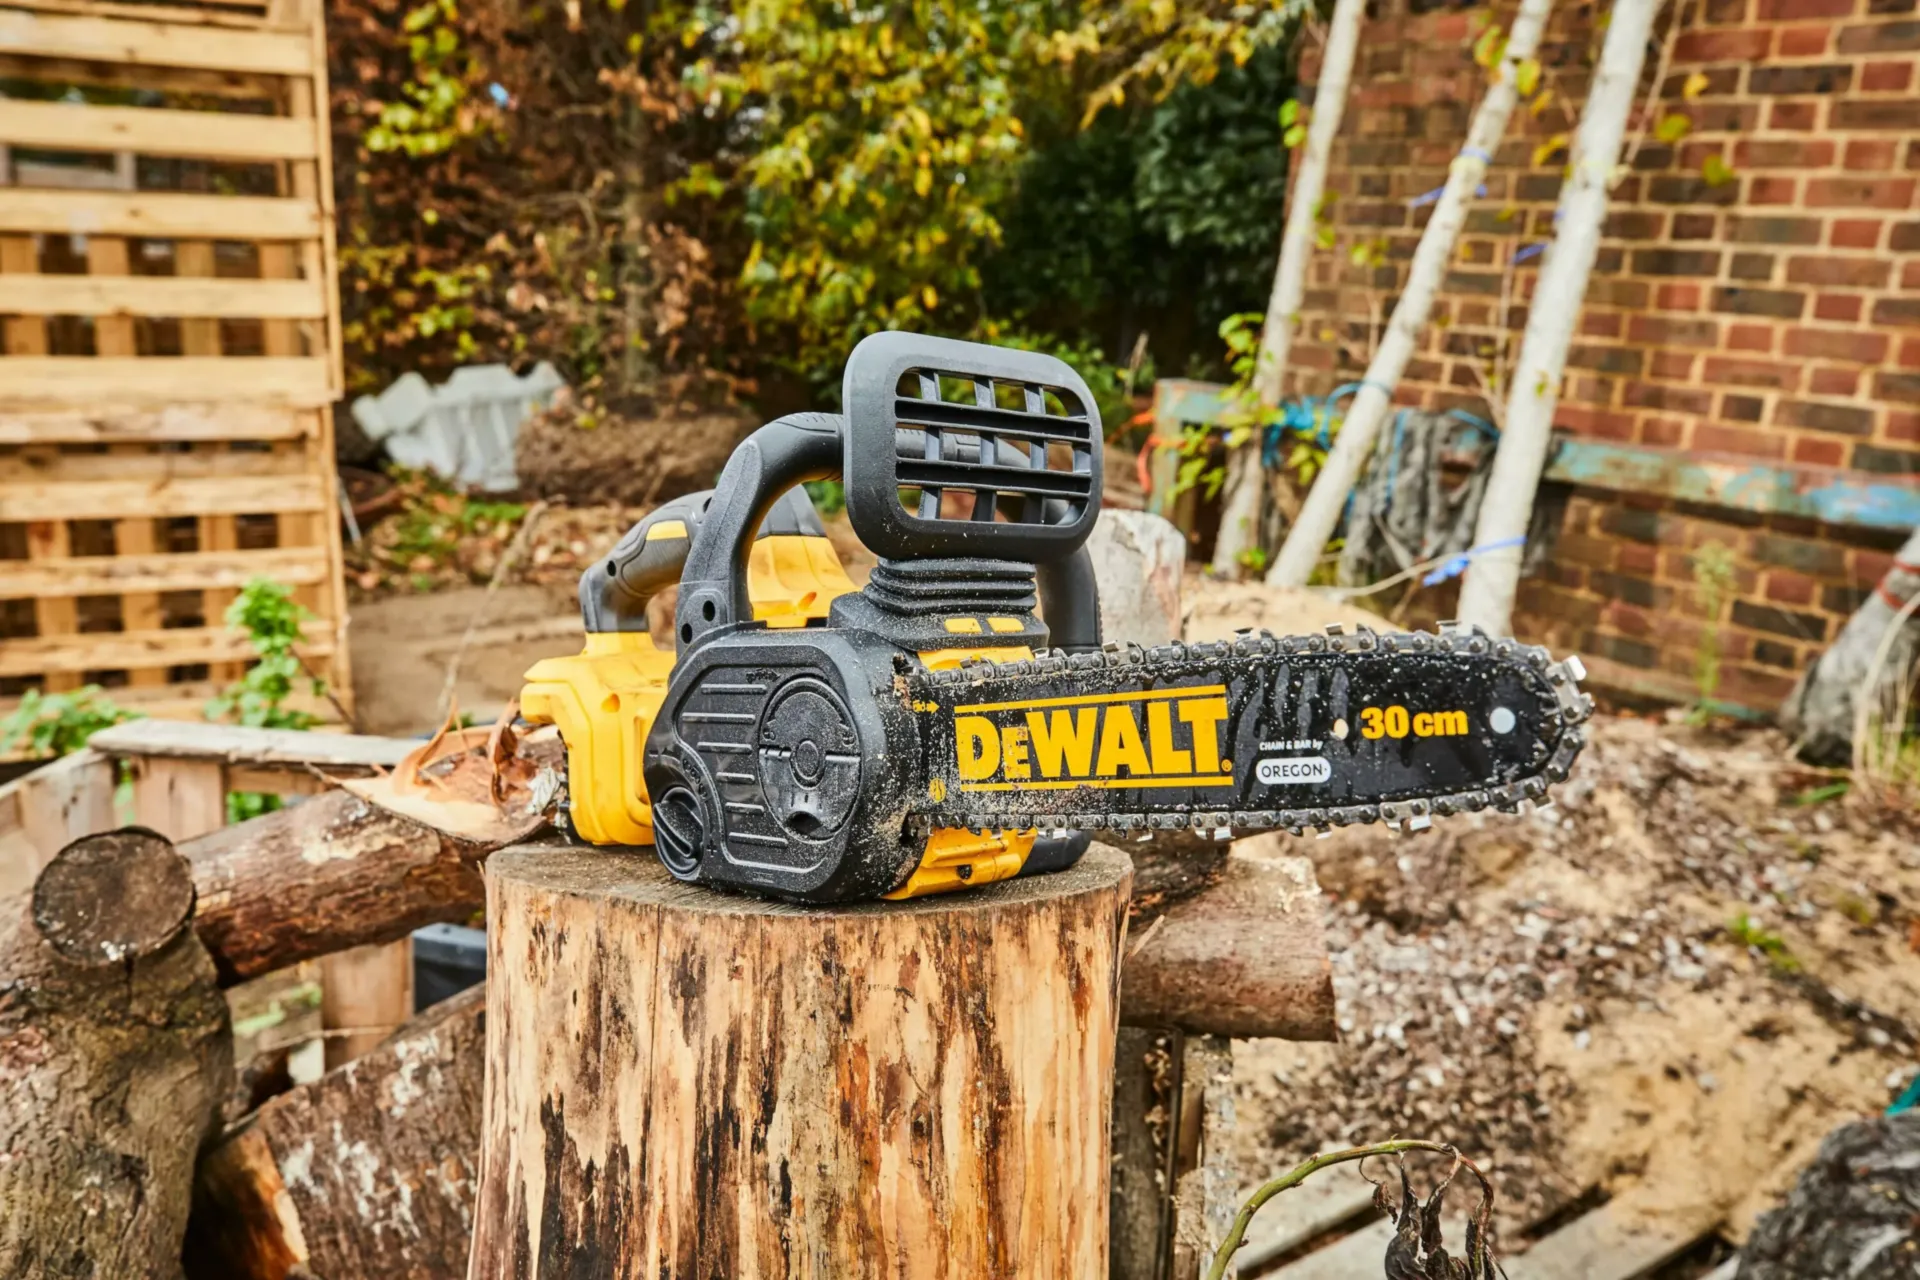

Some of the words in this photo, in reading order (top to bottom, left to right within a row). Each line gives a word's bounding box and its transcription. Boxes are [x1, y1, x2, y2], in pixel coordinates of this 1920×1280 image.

[1360, 705, 1410, 740] 30
[1412, 709, 1469, 738] cm
[1259, 741, 1285, 751] CHAIN
[1294, 740, 1312, 750] BAR
[1313, 739, 1323, 750] by
[1261, 763, 1323, 778] OREGON
